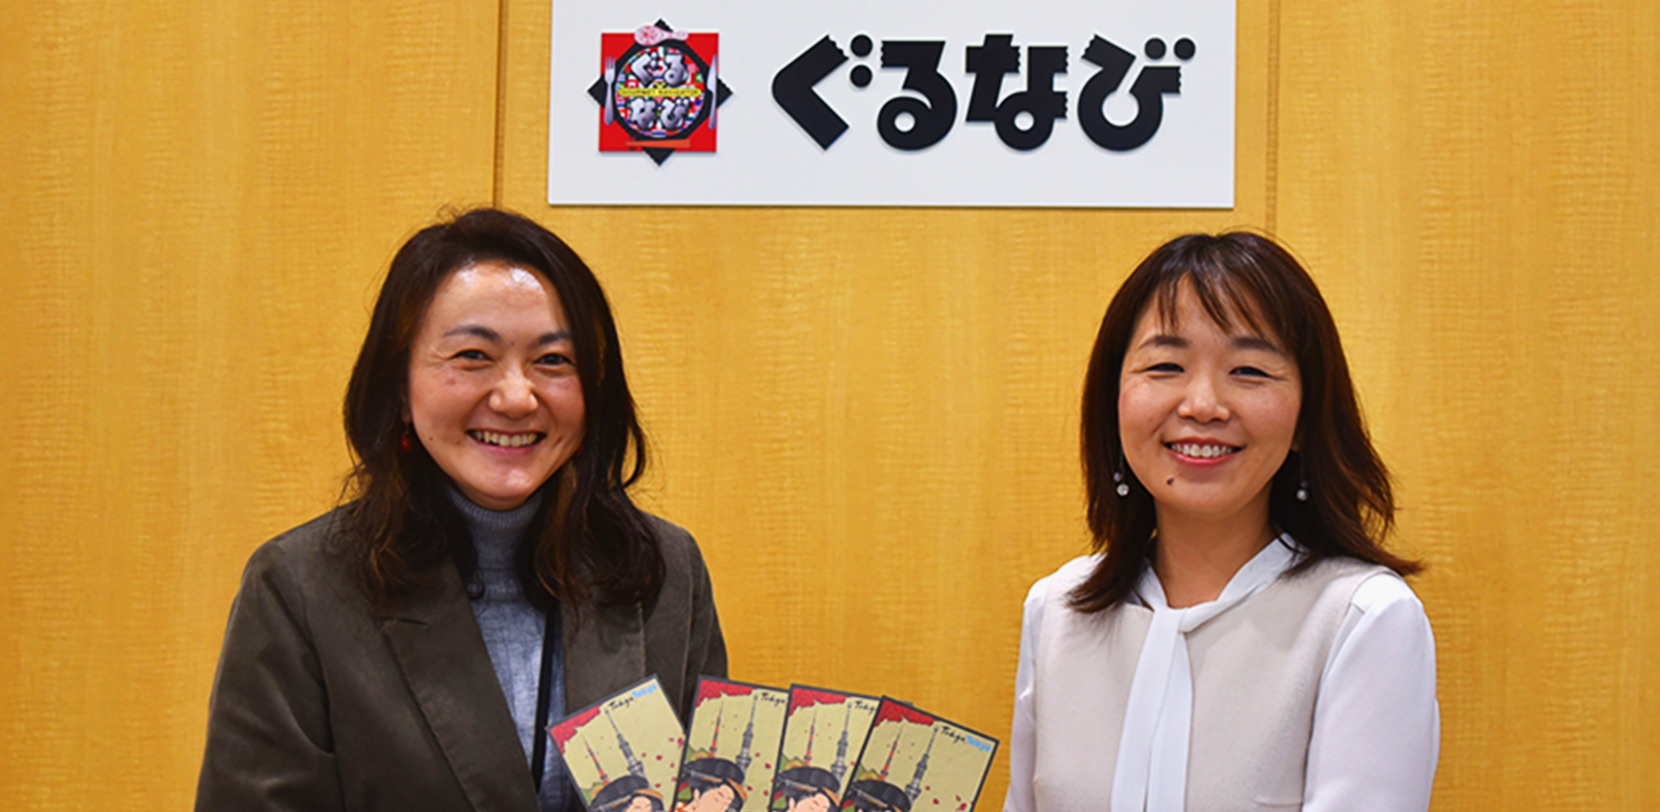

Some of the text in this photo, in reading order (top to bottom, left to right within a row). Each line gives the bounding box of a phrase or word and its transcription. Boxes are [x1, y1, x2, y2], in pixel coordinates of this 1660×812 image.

[630, 51, 688, 87] ぐる
[772, 34, 1196, 151] ぐるなび
[630, 97, 690, 130] なび
